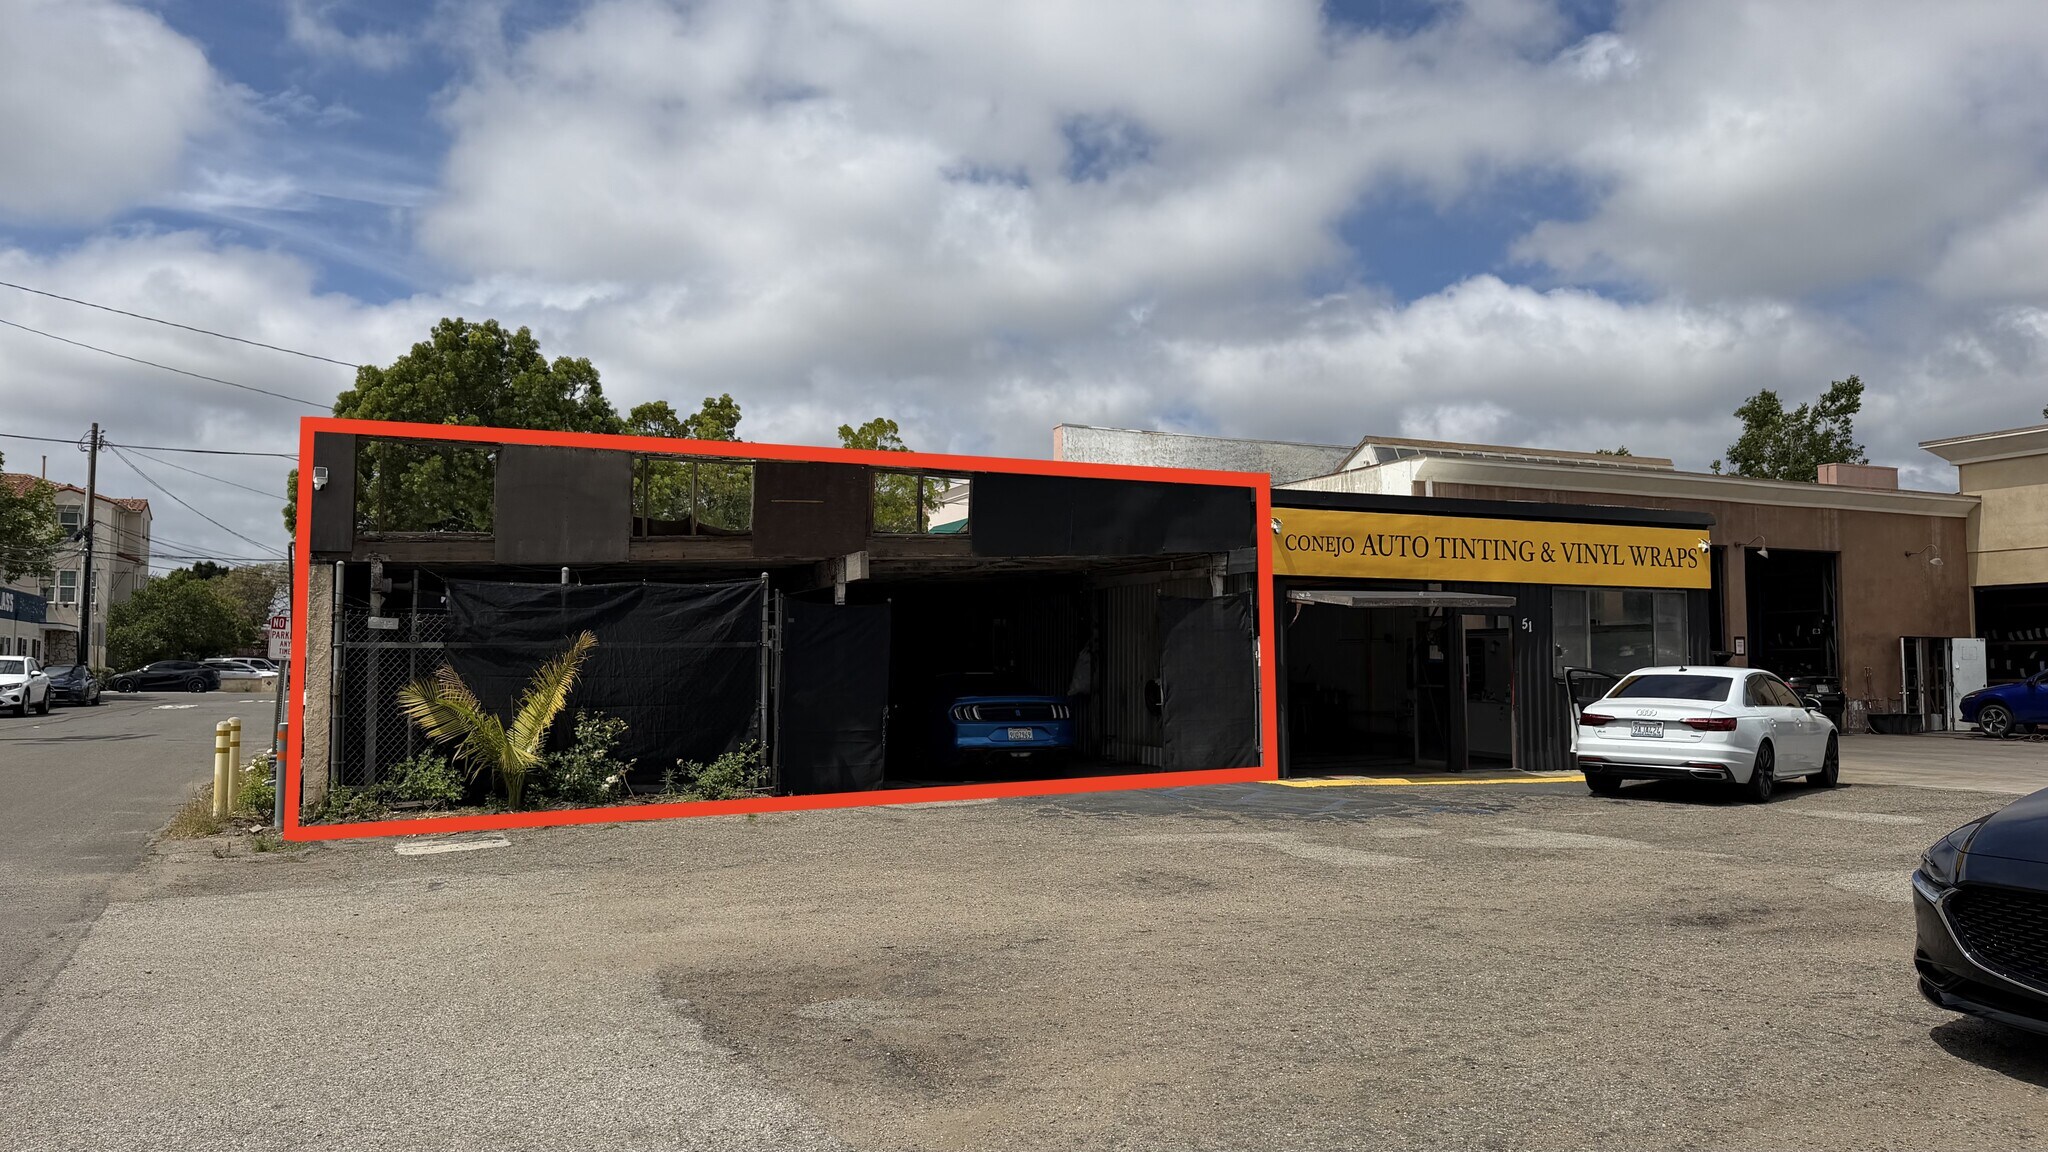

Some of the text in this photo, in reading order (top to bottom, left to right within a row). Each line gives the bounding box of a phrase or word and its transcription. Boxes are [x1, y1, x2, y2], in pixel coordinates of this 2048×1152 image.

[1285, 533, 1698, 569] CONEJO AUTO TINTING & VINYL WRAPS
[273, 618, 285, 628] NO
[1521, 617, 1533, 633] 51
[272, 631, 290, 639] PARK
